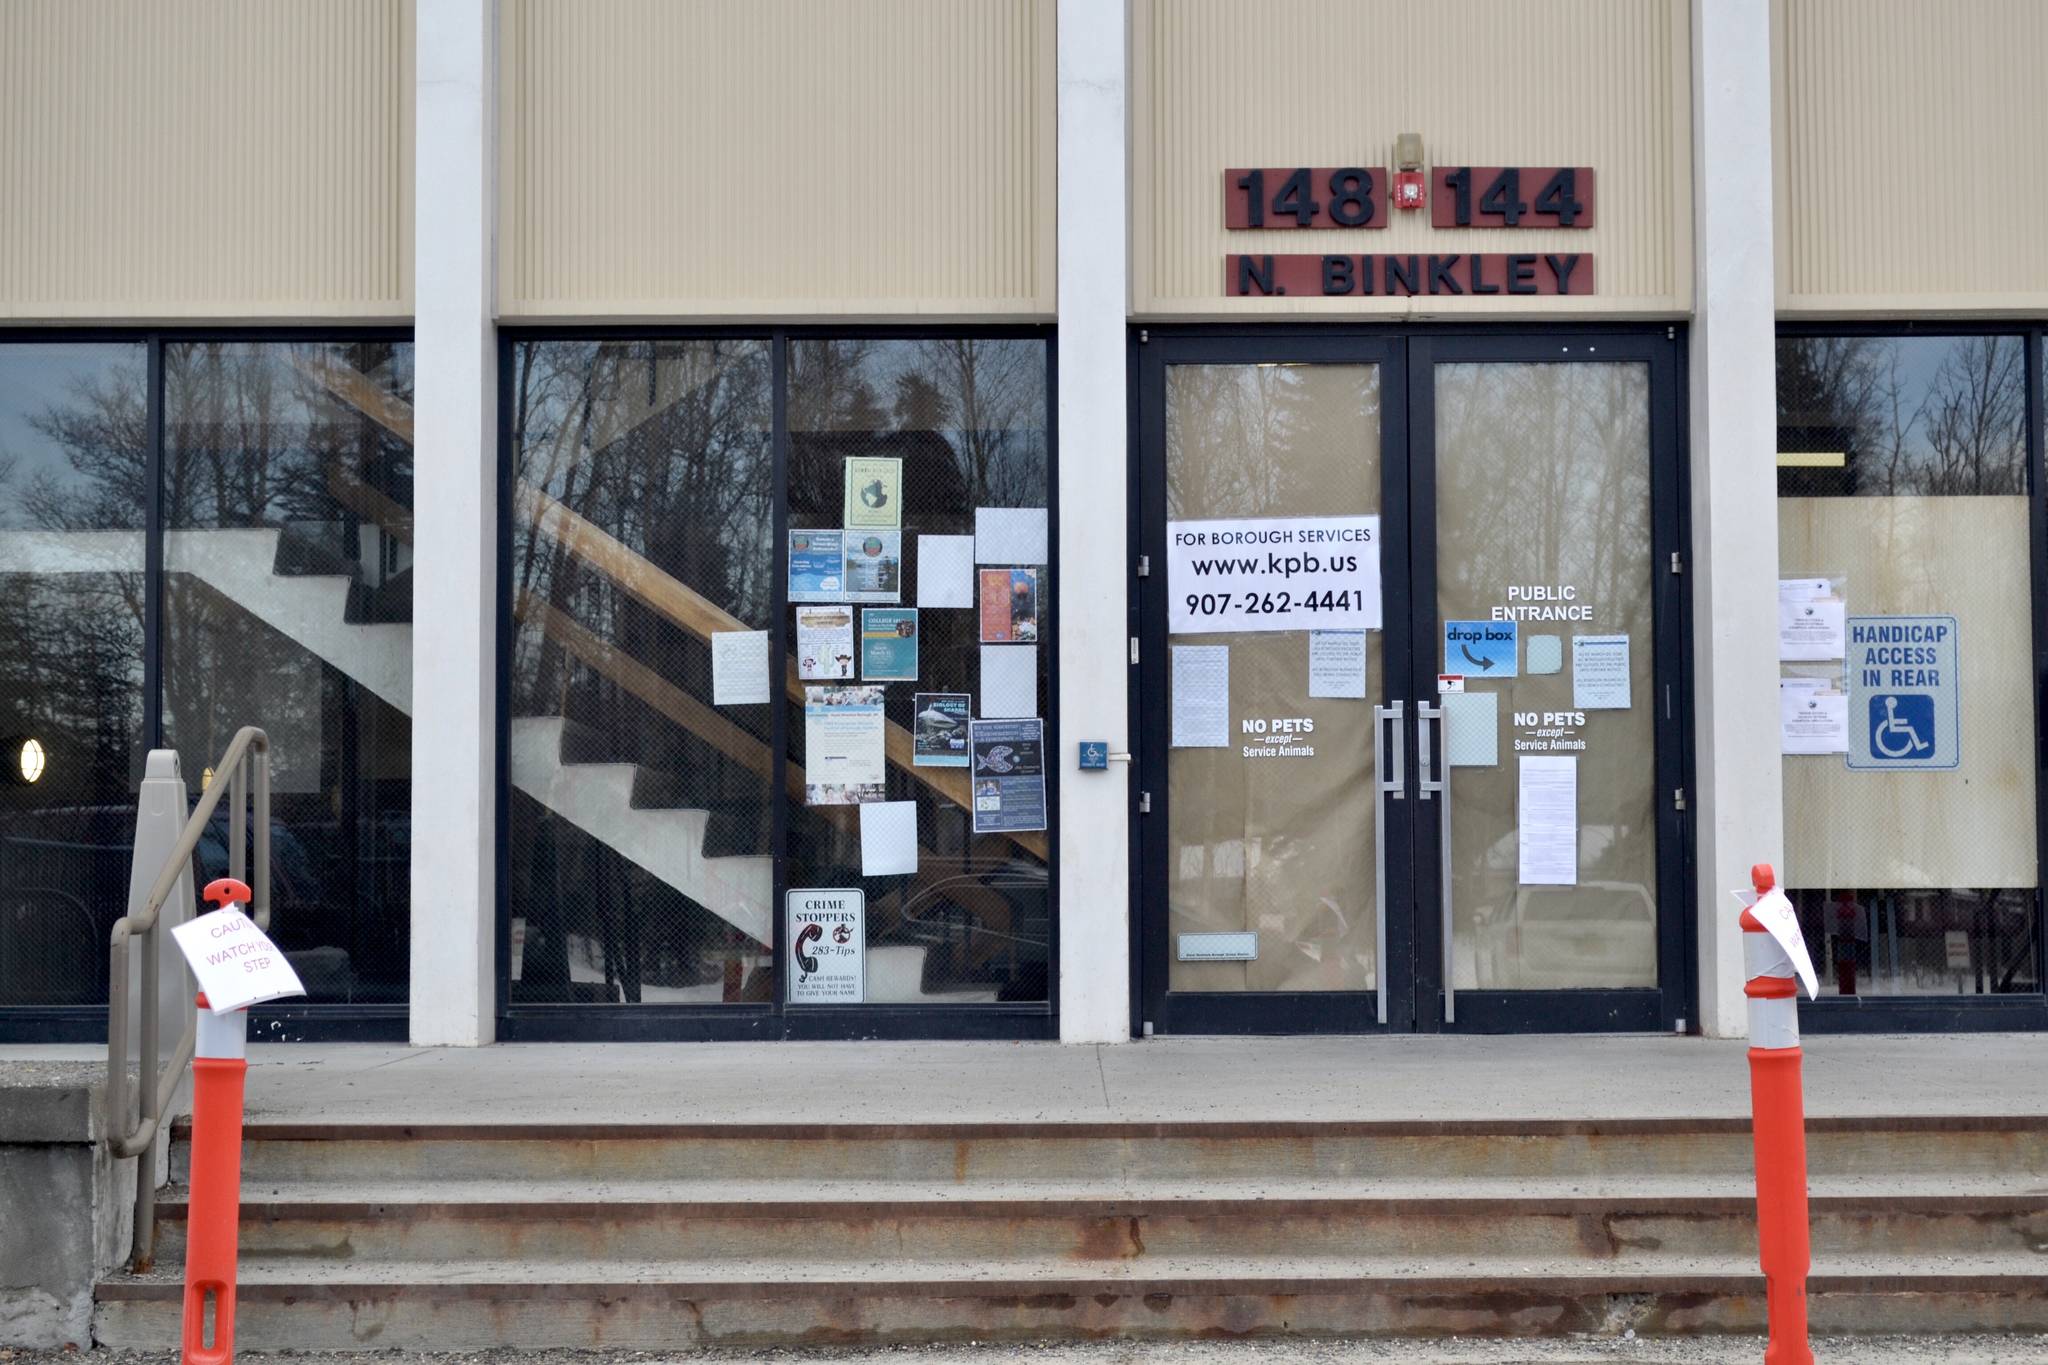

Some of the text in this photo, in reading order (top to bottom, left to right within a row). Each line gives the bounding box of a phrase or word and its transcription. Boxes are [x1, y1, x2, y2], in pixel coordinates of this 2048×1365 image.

[1238, 167, 1375, 227] 148
[1445, 166, 1584, 226] 144
[1238, 253, 1580, 296] N. BINKLEY
[1176, 529, 1371, 546] FOR BOROUGH SERVICES
[1191, 552, 1357, 579] www.kpb.us
[1508, 585, 1576, 601] PUBLIC
[1186, 590, 1363, 615] 907-262-4441
[1491, 606, 1593, 621] ENTRANCE
[1447, 627, 1513, 644] drop box
[1852, 625, 1948, 644] HANDICAP
[1865, 647, 1937, 665] ACCESS
[1862, 669, 1940, 687] IN REAR
[1242, 718, 1314, 733] NO PETS
[1514, 711, 1586, 727] NO PETS
[1265, 734, 1293, 745] except
[1536, 727, 1564, 738] except
[1243, 745, 1314, 758] Service Animals
[1514, 738, 1586, 751] Service Animals
[805, 900, 845, 910] CRIME
[795, 913, 856, 923] STOPPERS
[206, 942, 256, 966] WATCH
[812, 945, 856, 957] 283-Tips
[243, 957, 271, 973] STEP
